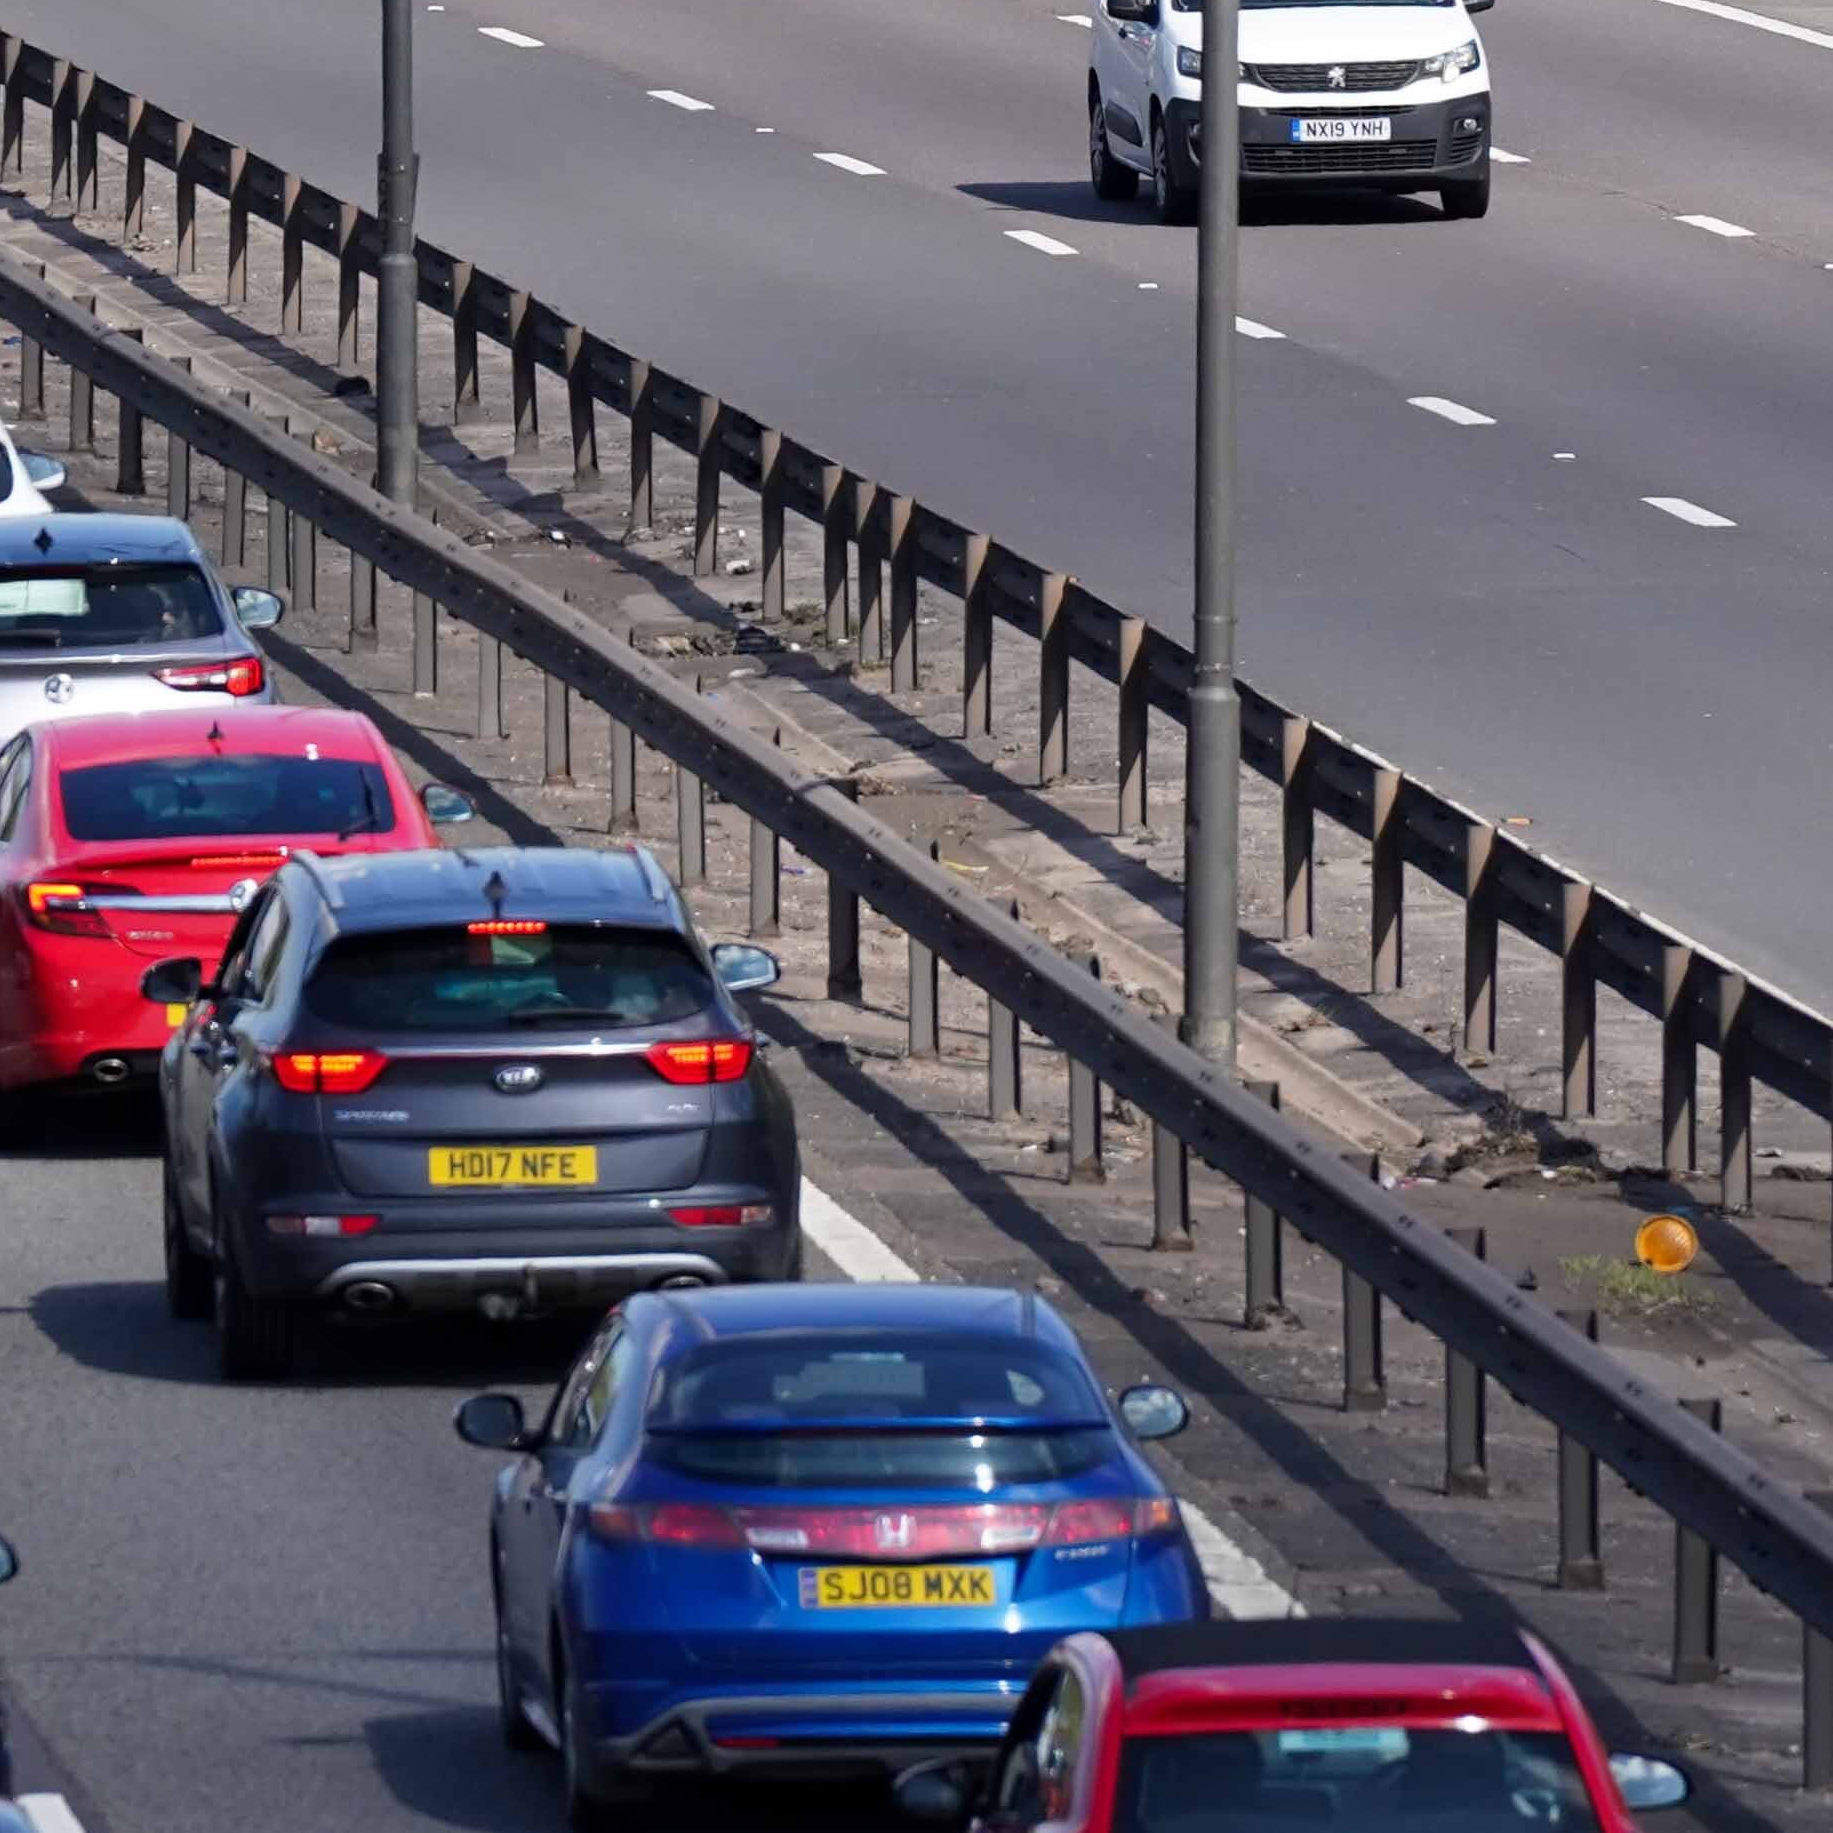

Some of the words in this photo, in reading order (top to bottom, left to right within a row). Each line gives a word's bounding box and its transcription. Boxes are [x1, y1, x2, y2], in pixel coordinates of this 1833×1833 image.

[1306, 122, 1344, 137] NX19
[1351, 120, 1383, 135] YNH
[449, 1156, 510, 1180] HD17
[521, 1153, 577, 1179] NFE
[825, 1572, 911, 1601] SJ08
[925, 1571, 991, 1600] MXK
